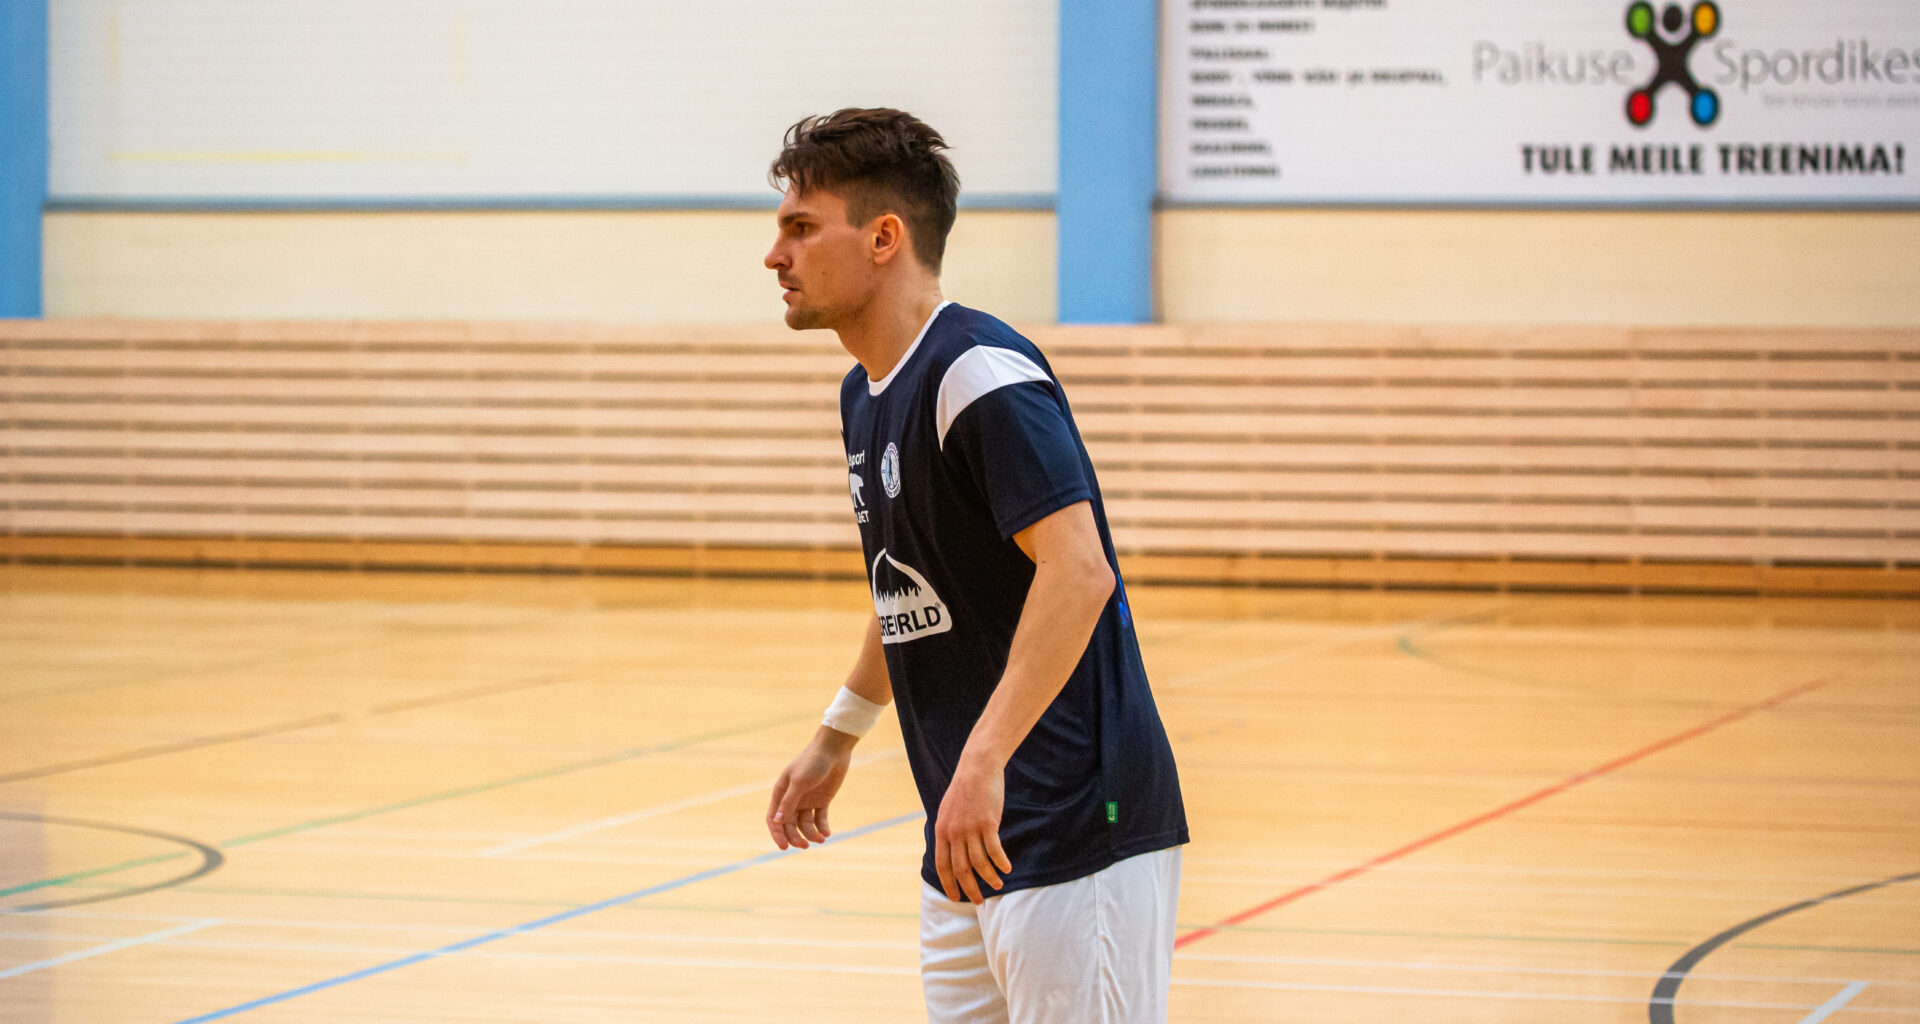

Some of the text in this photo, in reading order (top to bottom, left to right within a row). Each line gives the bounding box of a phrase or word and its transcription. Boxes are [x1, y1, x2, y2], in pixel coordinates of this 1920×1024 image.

[1473, 40, 1635, 86] Paikuse
[1521, 144, 1905, 174] TULE MEILE TREENIMA!
[848, 450, 866, 470] sport
